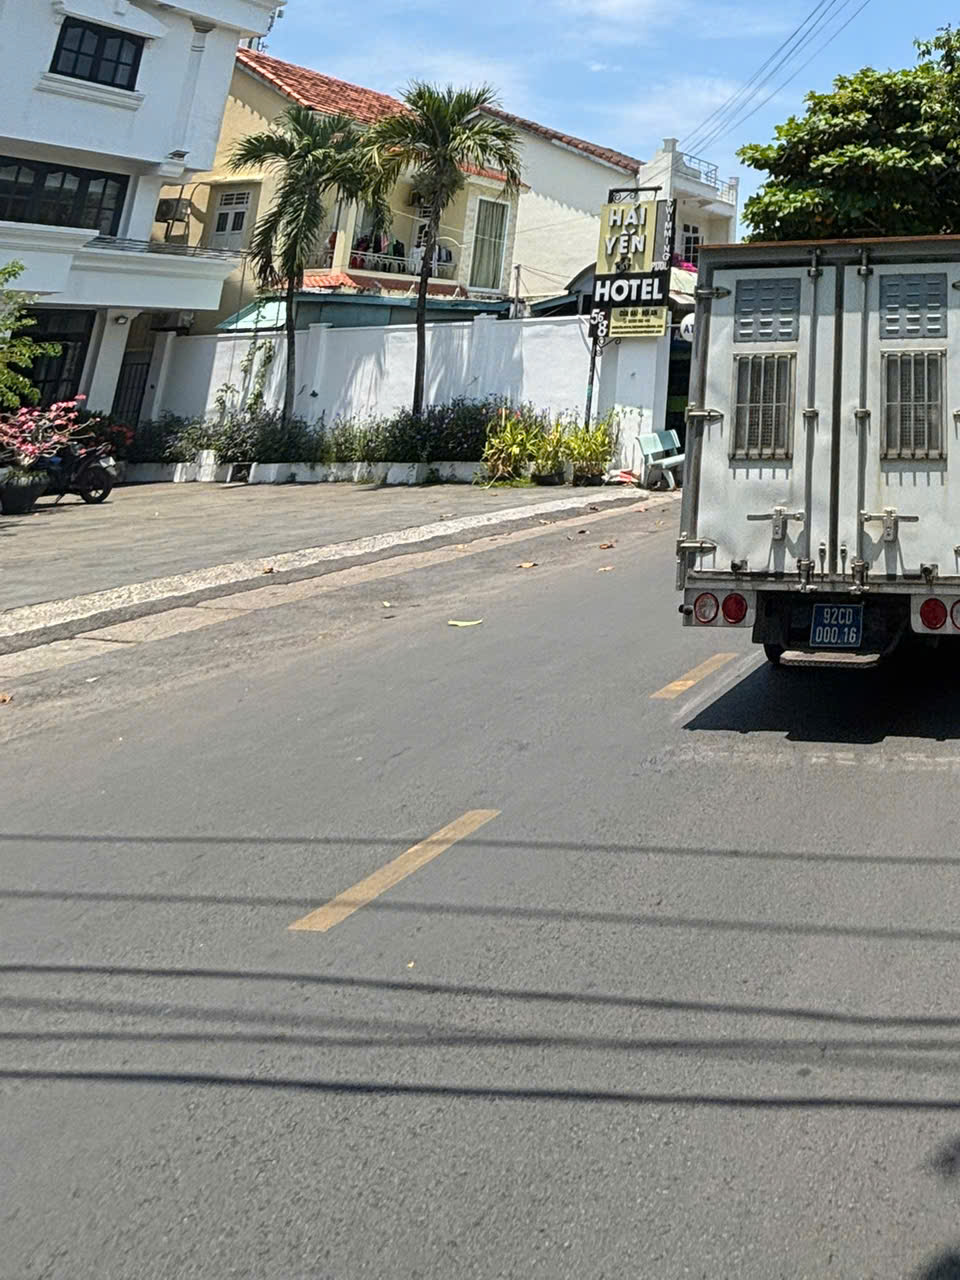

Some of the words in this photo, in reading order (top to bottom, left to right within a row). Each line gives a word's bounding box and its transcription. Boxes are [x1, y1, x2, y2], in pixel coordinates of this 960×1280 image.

[609, 202, 646, 227] HẢI
[662, 198, 674, 261] SWIMMING
[605, 228, 645, 256] YẾN
[652, 261, 668, 271] POOL
[594, 278, 663, 302] HOTEL
[823, 607, 853, 625] 92CD
[815, 626, 857, 643] 000.16
